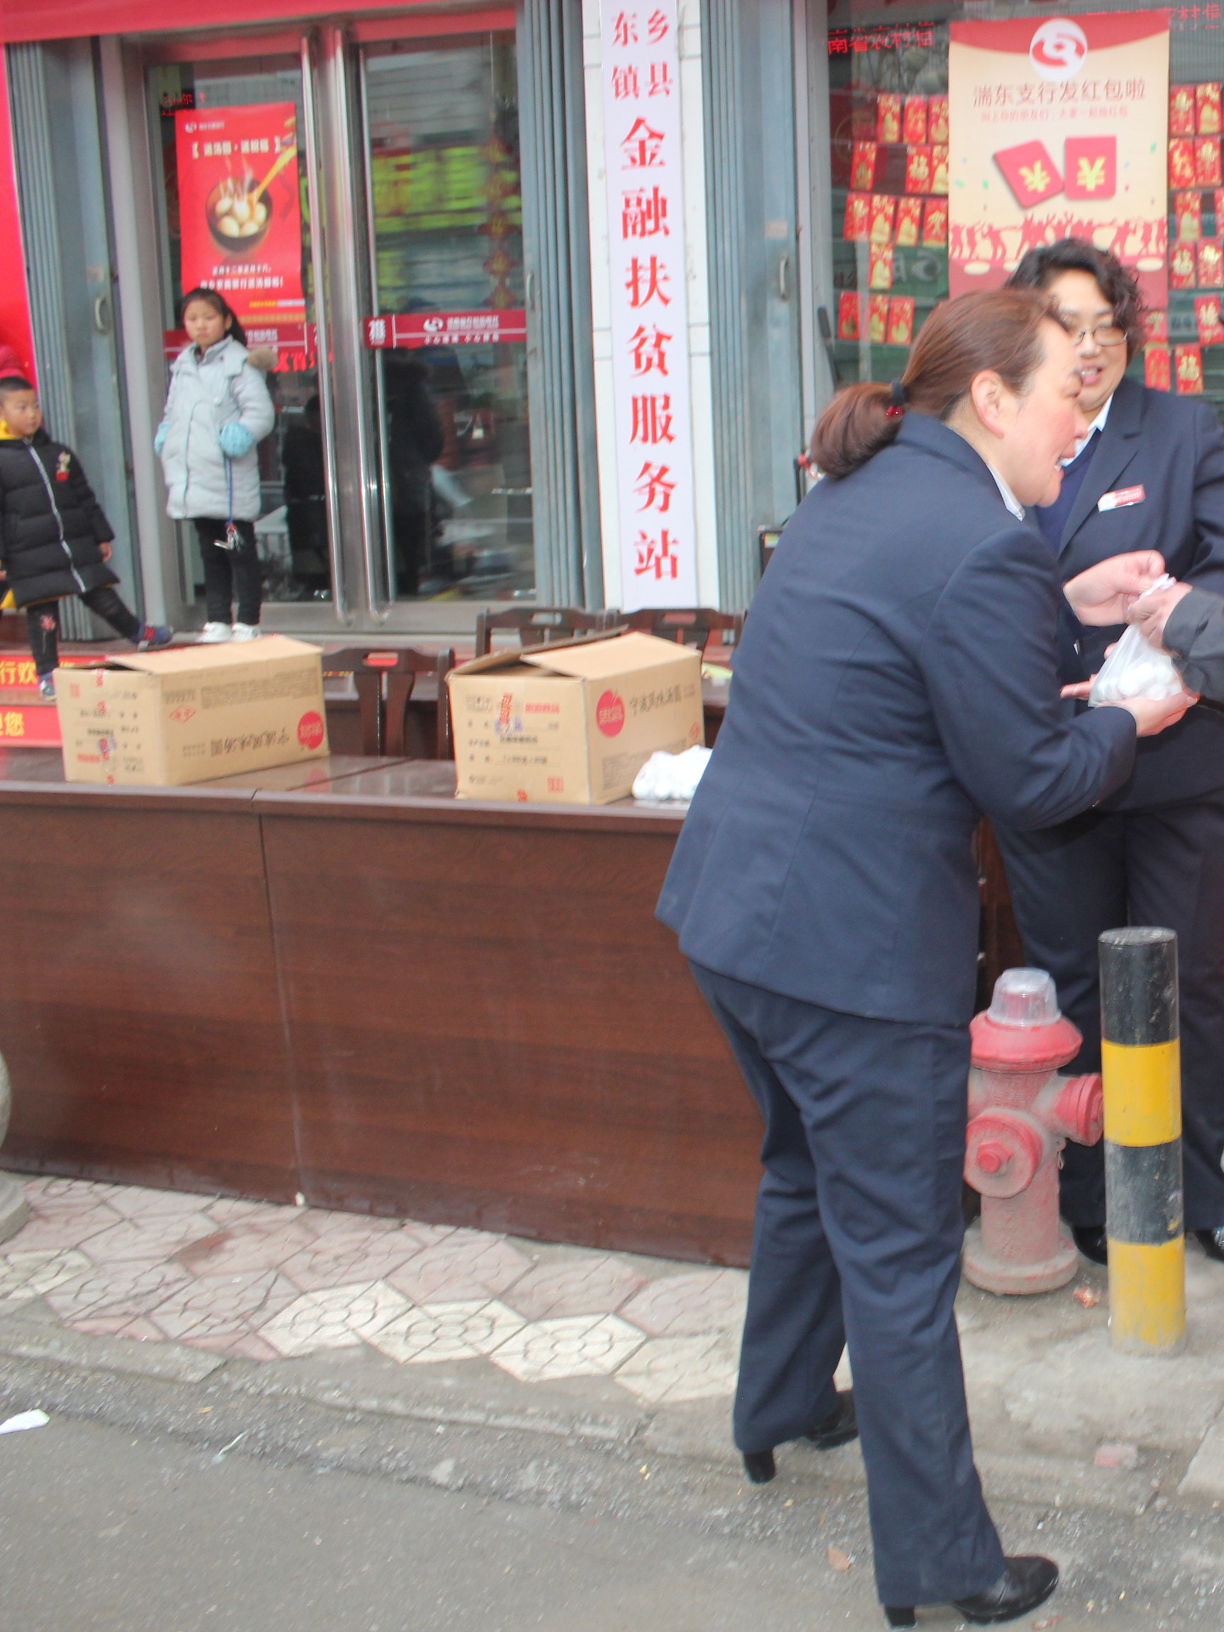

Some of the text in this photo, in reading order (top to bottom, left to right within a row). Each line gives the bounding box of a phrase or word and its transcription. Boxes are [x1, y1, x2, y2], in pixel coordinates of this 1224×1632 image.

[620, 116, 679, 581] 金融扶贫服务站
